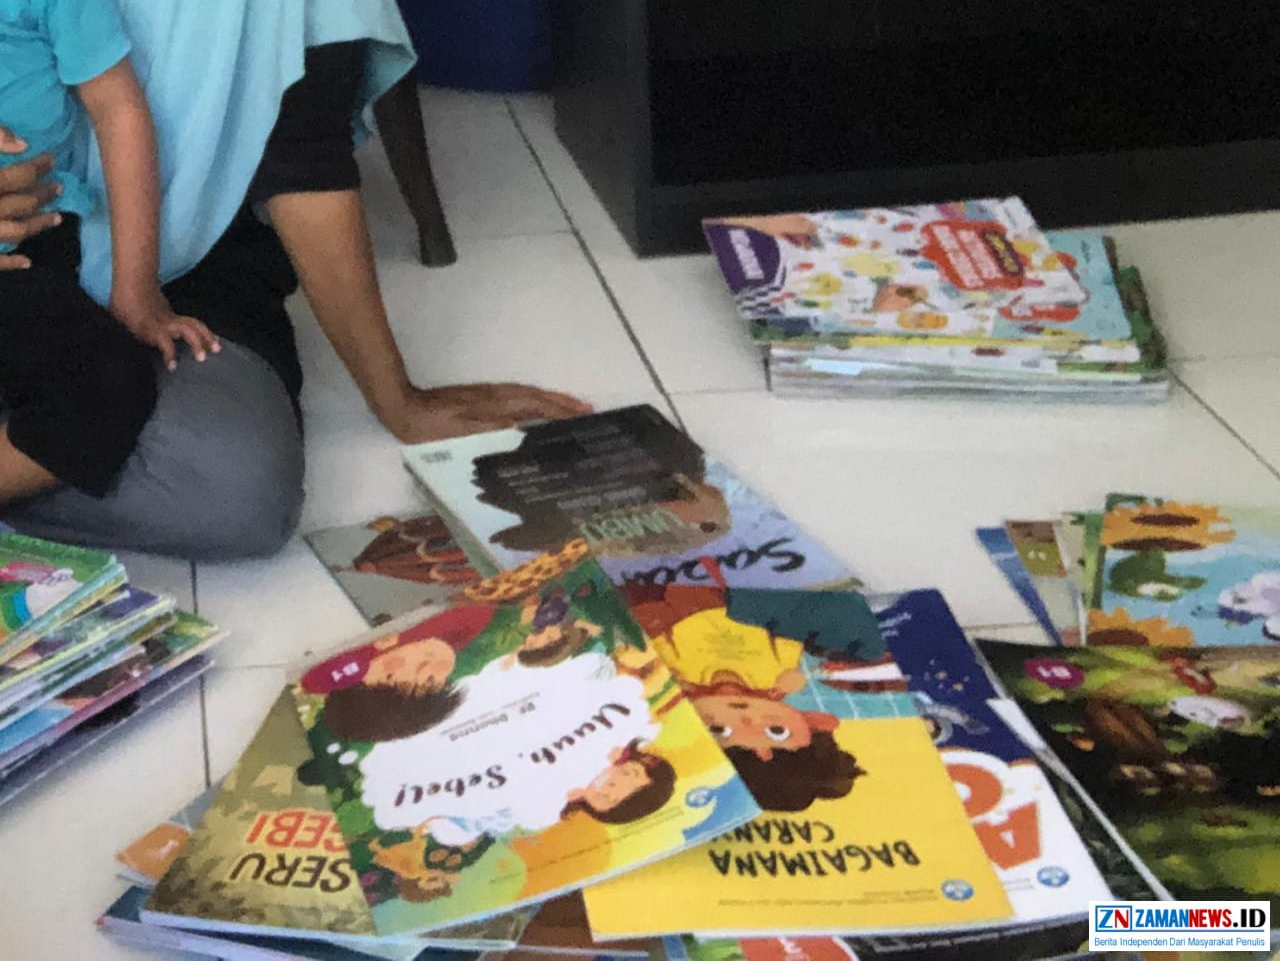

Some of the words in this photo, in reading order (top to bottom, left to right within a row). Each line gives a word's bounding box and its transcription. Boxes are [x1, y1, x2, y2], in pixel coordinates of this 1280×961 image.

[394, 764, 507, 807] Sebel!
[229, 851, 351, 894] SERU
[708, 839, 921, 878] BAGAIMANA
